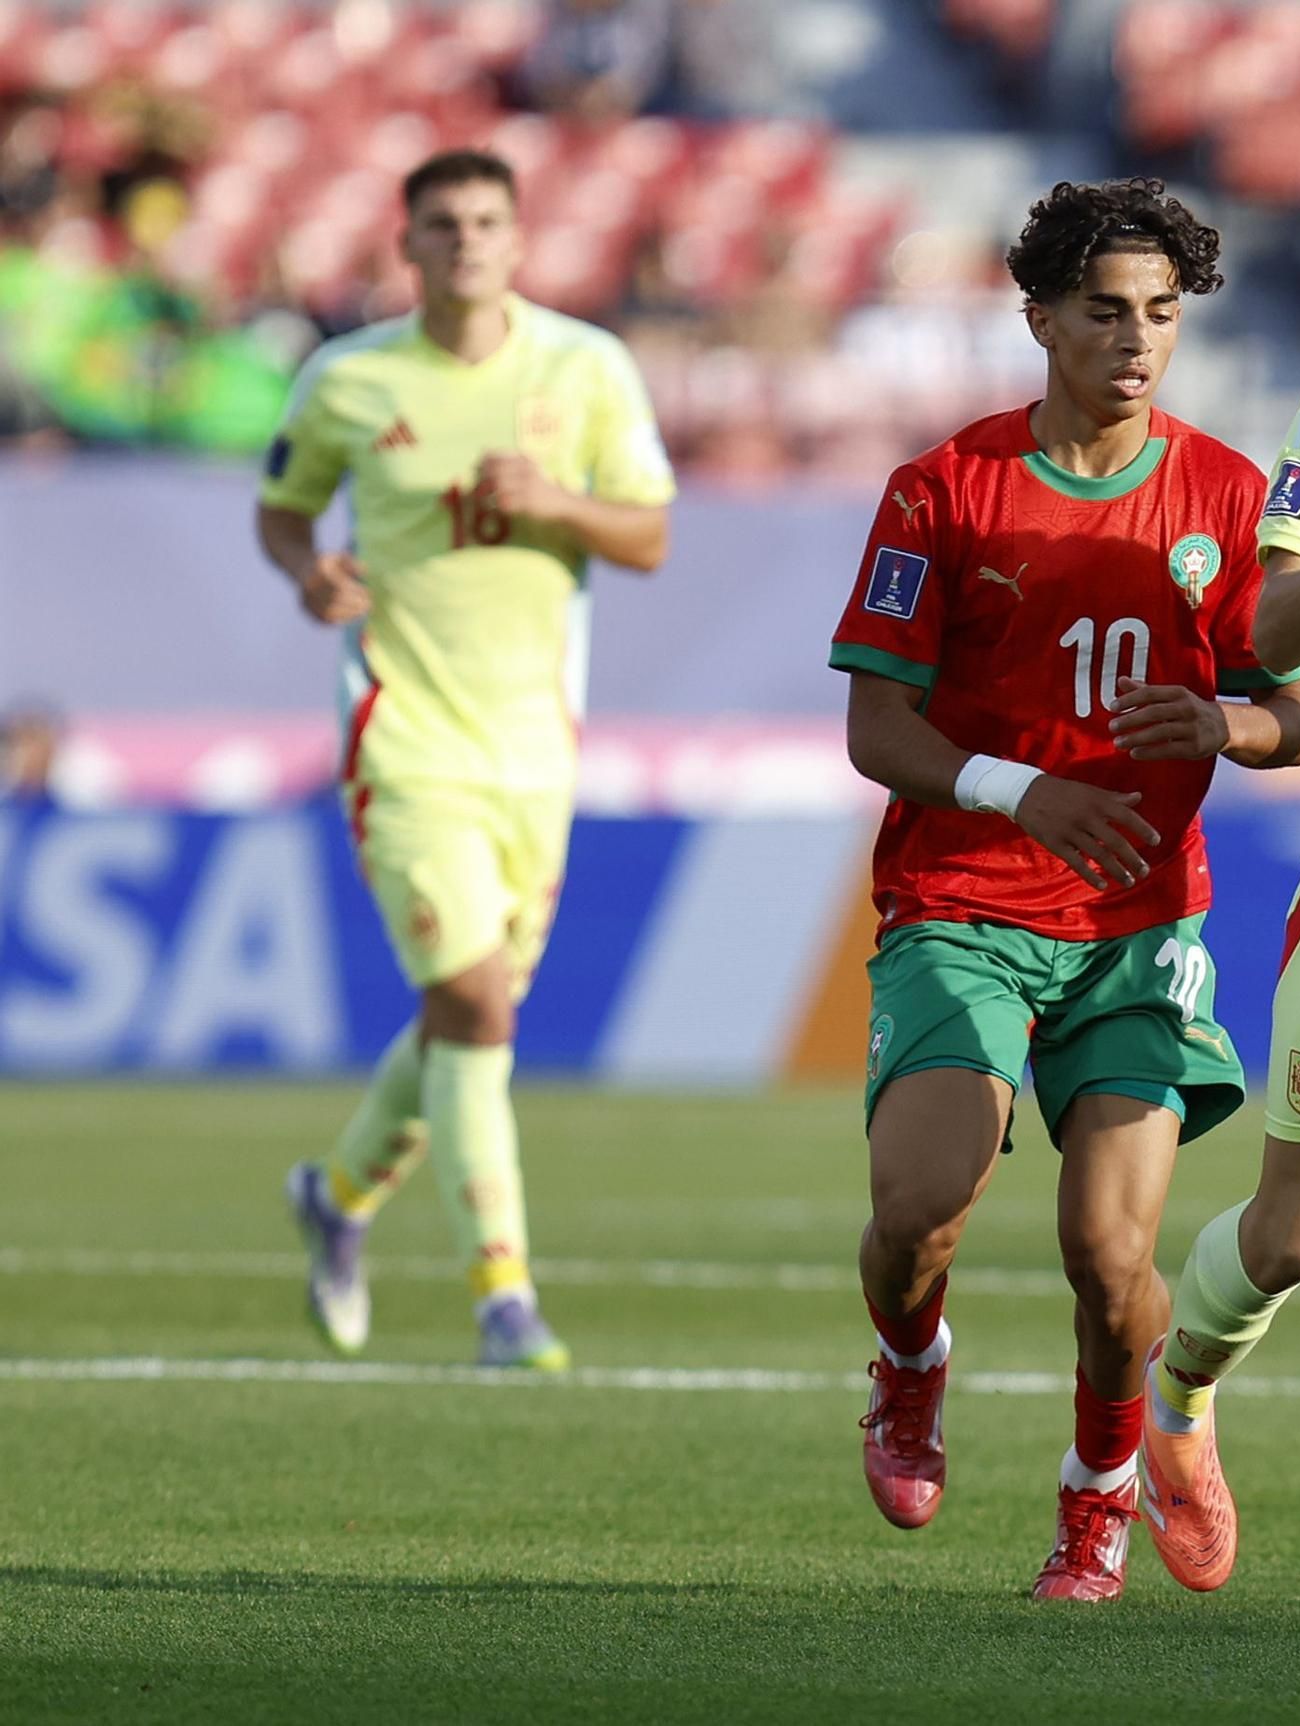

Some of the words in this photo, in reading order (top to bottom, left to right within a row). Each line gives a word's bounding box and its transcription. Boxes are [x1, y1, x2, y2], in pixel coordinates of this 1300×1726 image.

[1059, 616, 1150, 718] 10
[0, 812, 350, 1070] SA
[1154, 937, 1207, 1024] 10
